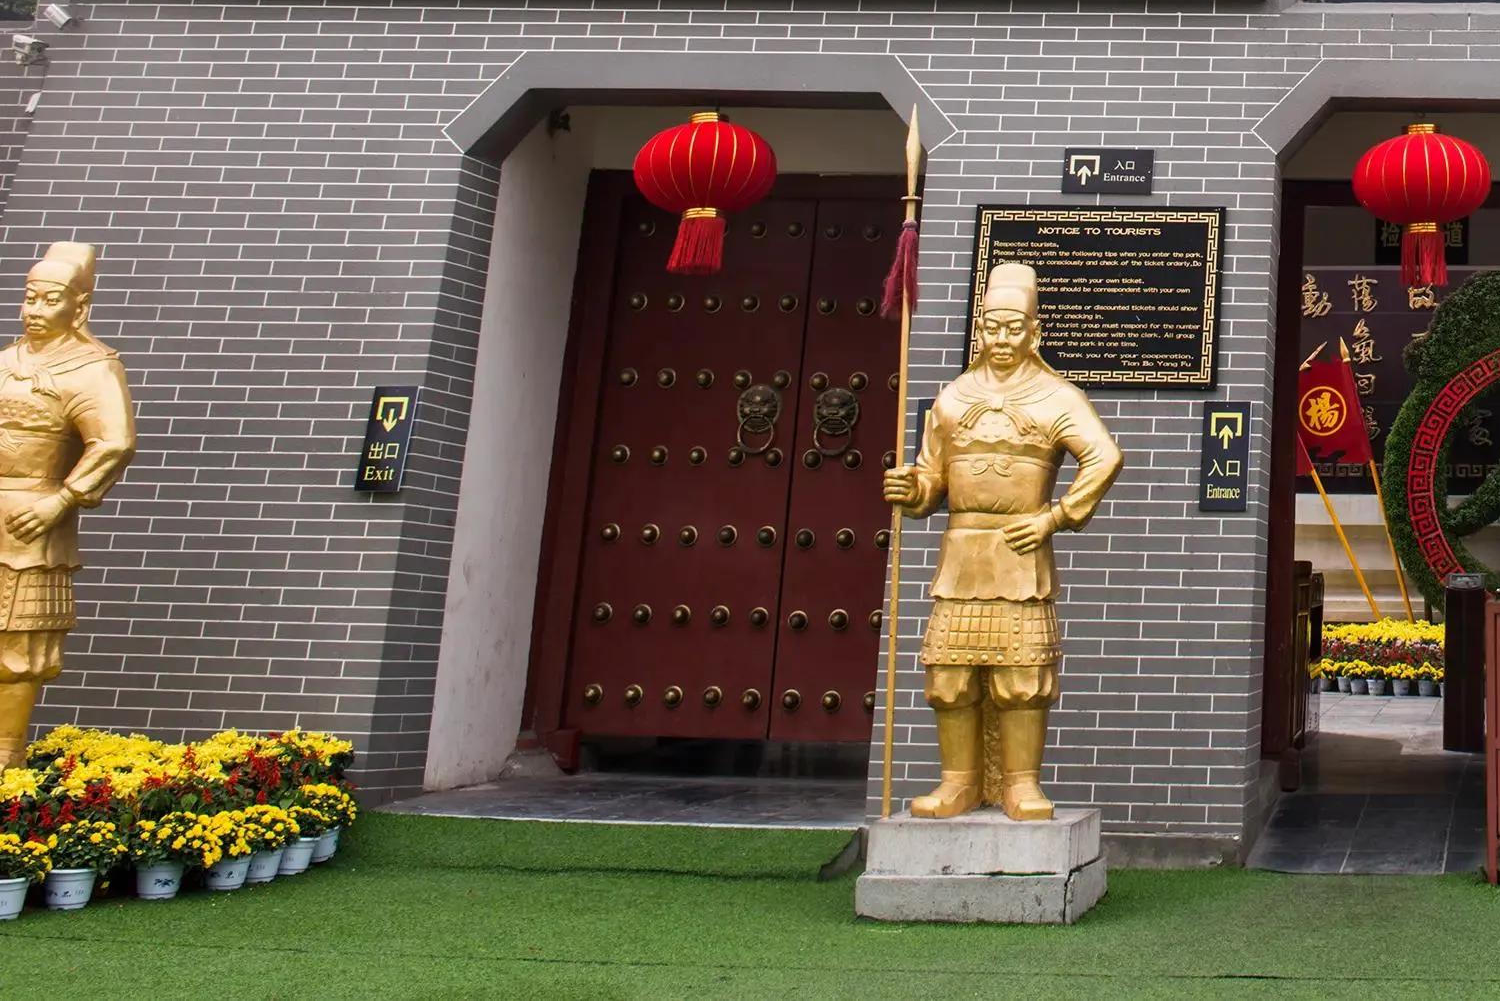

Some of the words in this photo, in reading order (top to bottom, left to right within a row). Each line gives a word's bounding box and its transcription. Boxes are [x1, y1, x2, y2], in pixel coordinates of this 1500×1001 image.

[1114, 159, 1136, 170] 入口
[1103, 172, 1146, 183] Entrance
[1037, 226, 1080, 235] NOTICE
[1083, 227, 1101, 235] TO
[1104, 227, 1161, 235] TOURISTS
[1381, 221, 1464, 249] 检道
[1305, 391, 1340, 431] 楊
[368, 441, 400, 460] 出口
[363, 465, 395, 481] Exit
[1207, 458, 1241, 477] 入口
[1206, 483, 1241, 499] Entrance
